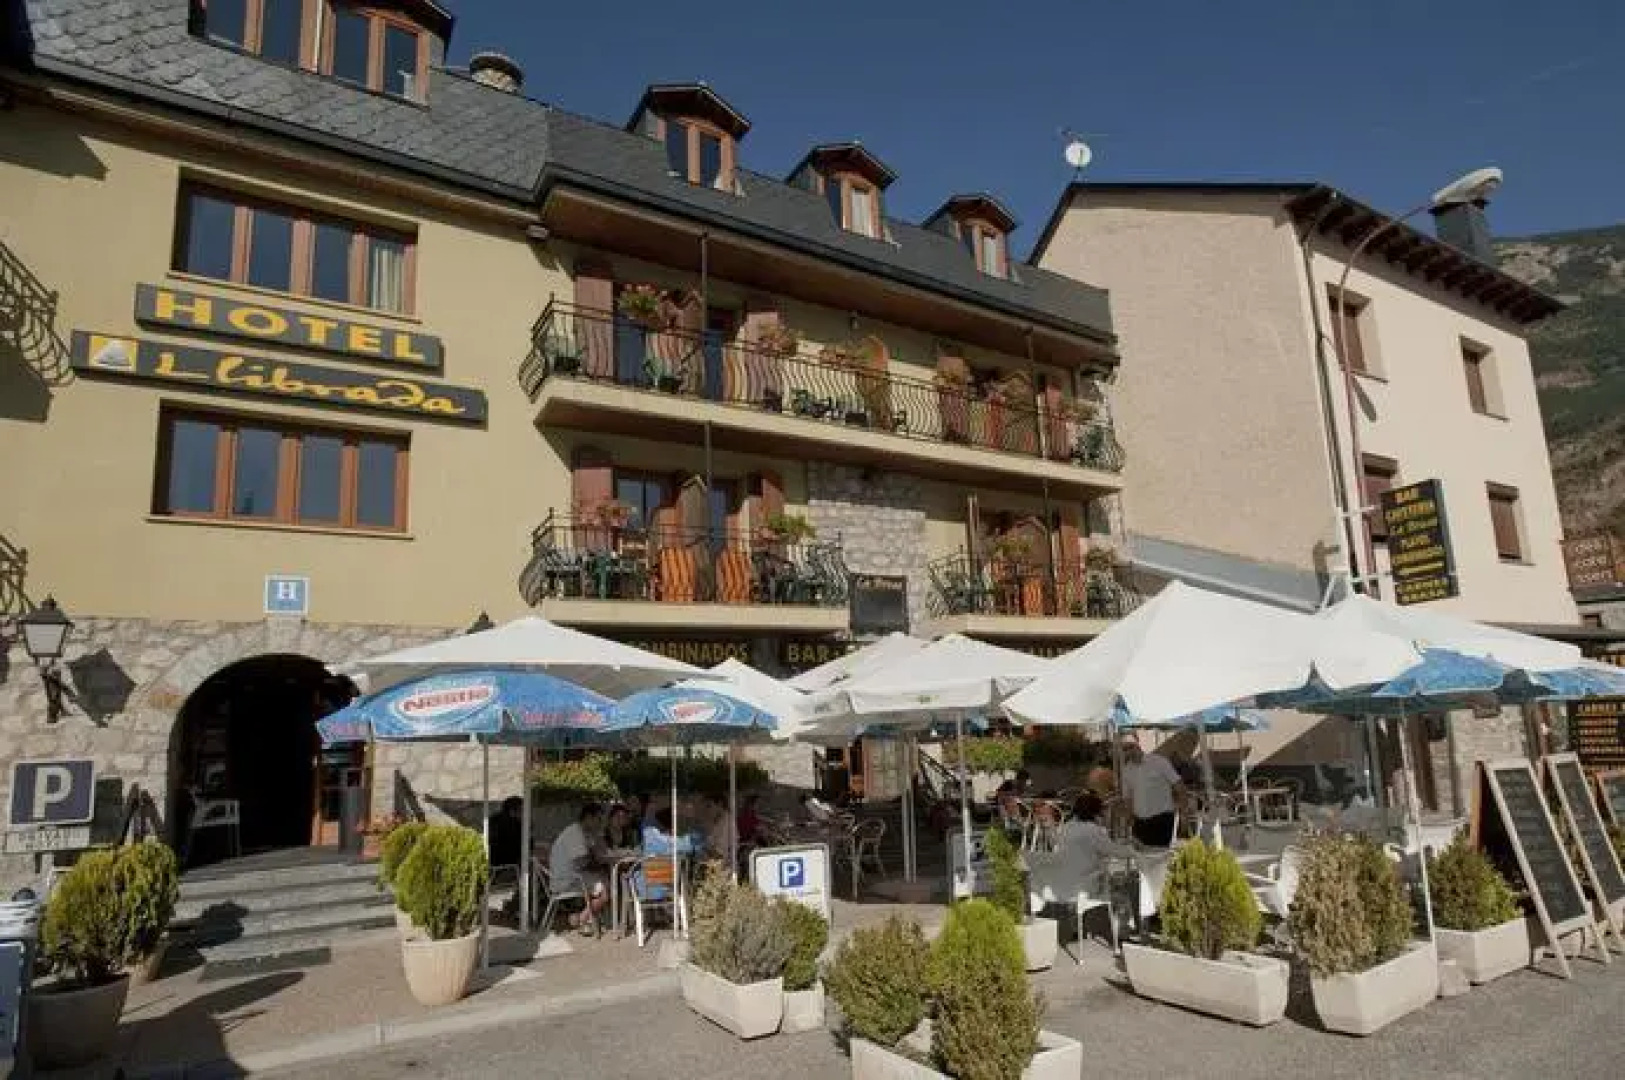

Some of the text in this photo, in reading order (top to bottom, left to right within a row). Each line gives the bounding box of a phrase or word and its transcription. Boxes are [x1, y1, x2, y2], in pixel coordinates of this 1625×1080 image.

[154, 290, 427, 362] HOTEL
[277, 581, 297, 600] H
[33, 766, 73, 818] P
[781, 861, 800, 886] P
